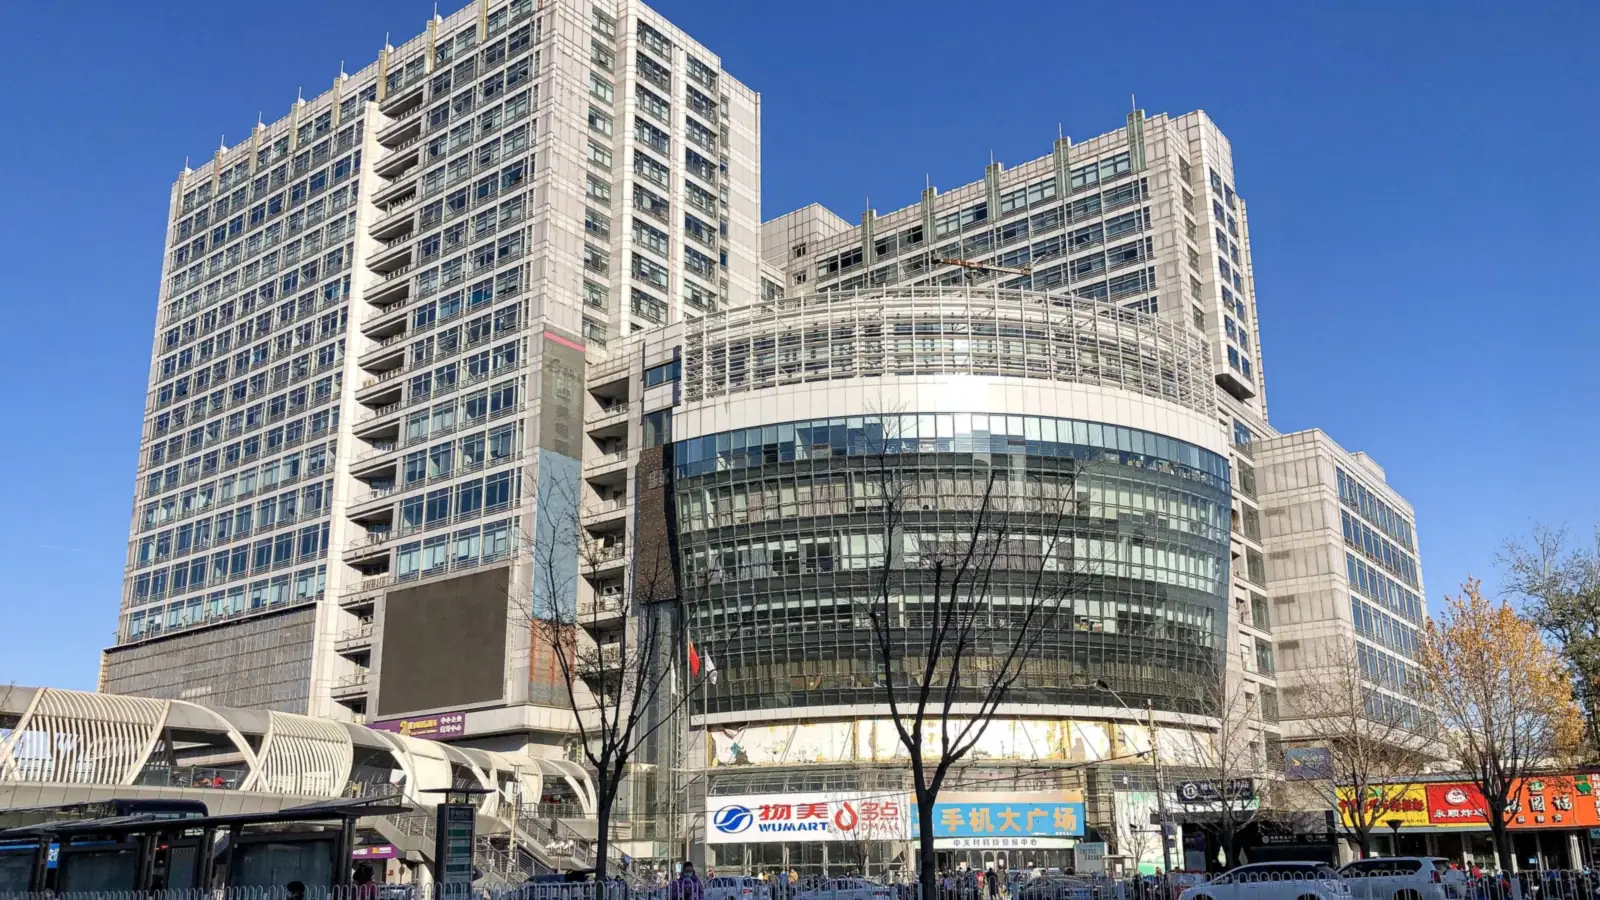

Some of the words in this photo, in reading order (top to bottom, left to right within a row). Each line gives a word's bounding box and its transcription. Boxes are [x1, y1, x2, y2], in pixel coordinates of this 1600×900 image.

[758, 802, 829, 821] 物美
[861, 801, 899, 821] 多点
[912, 807, 1078, 833] 手机大广场
[758, 821, 829, 833] WUMART
